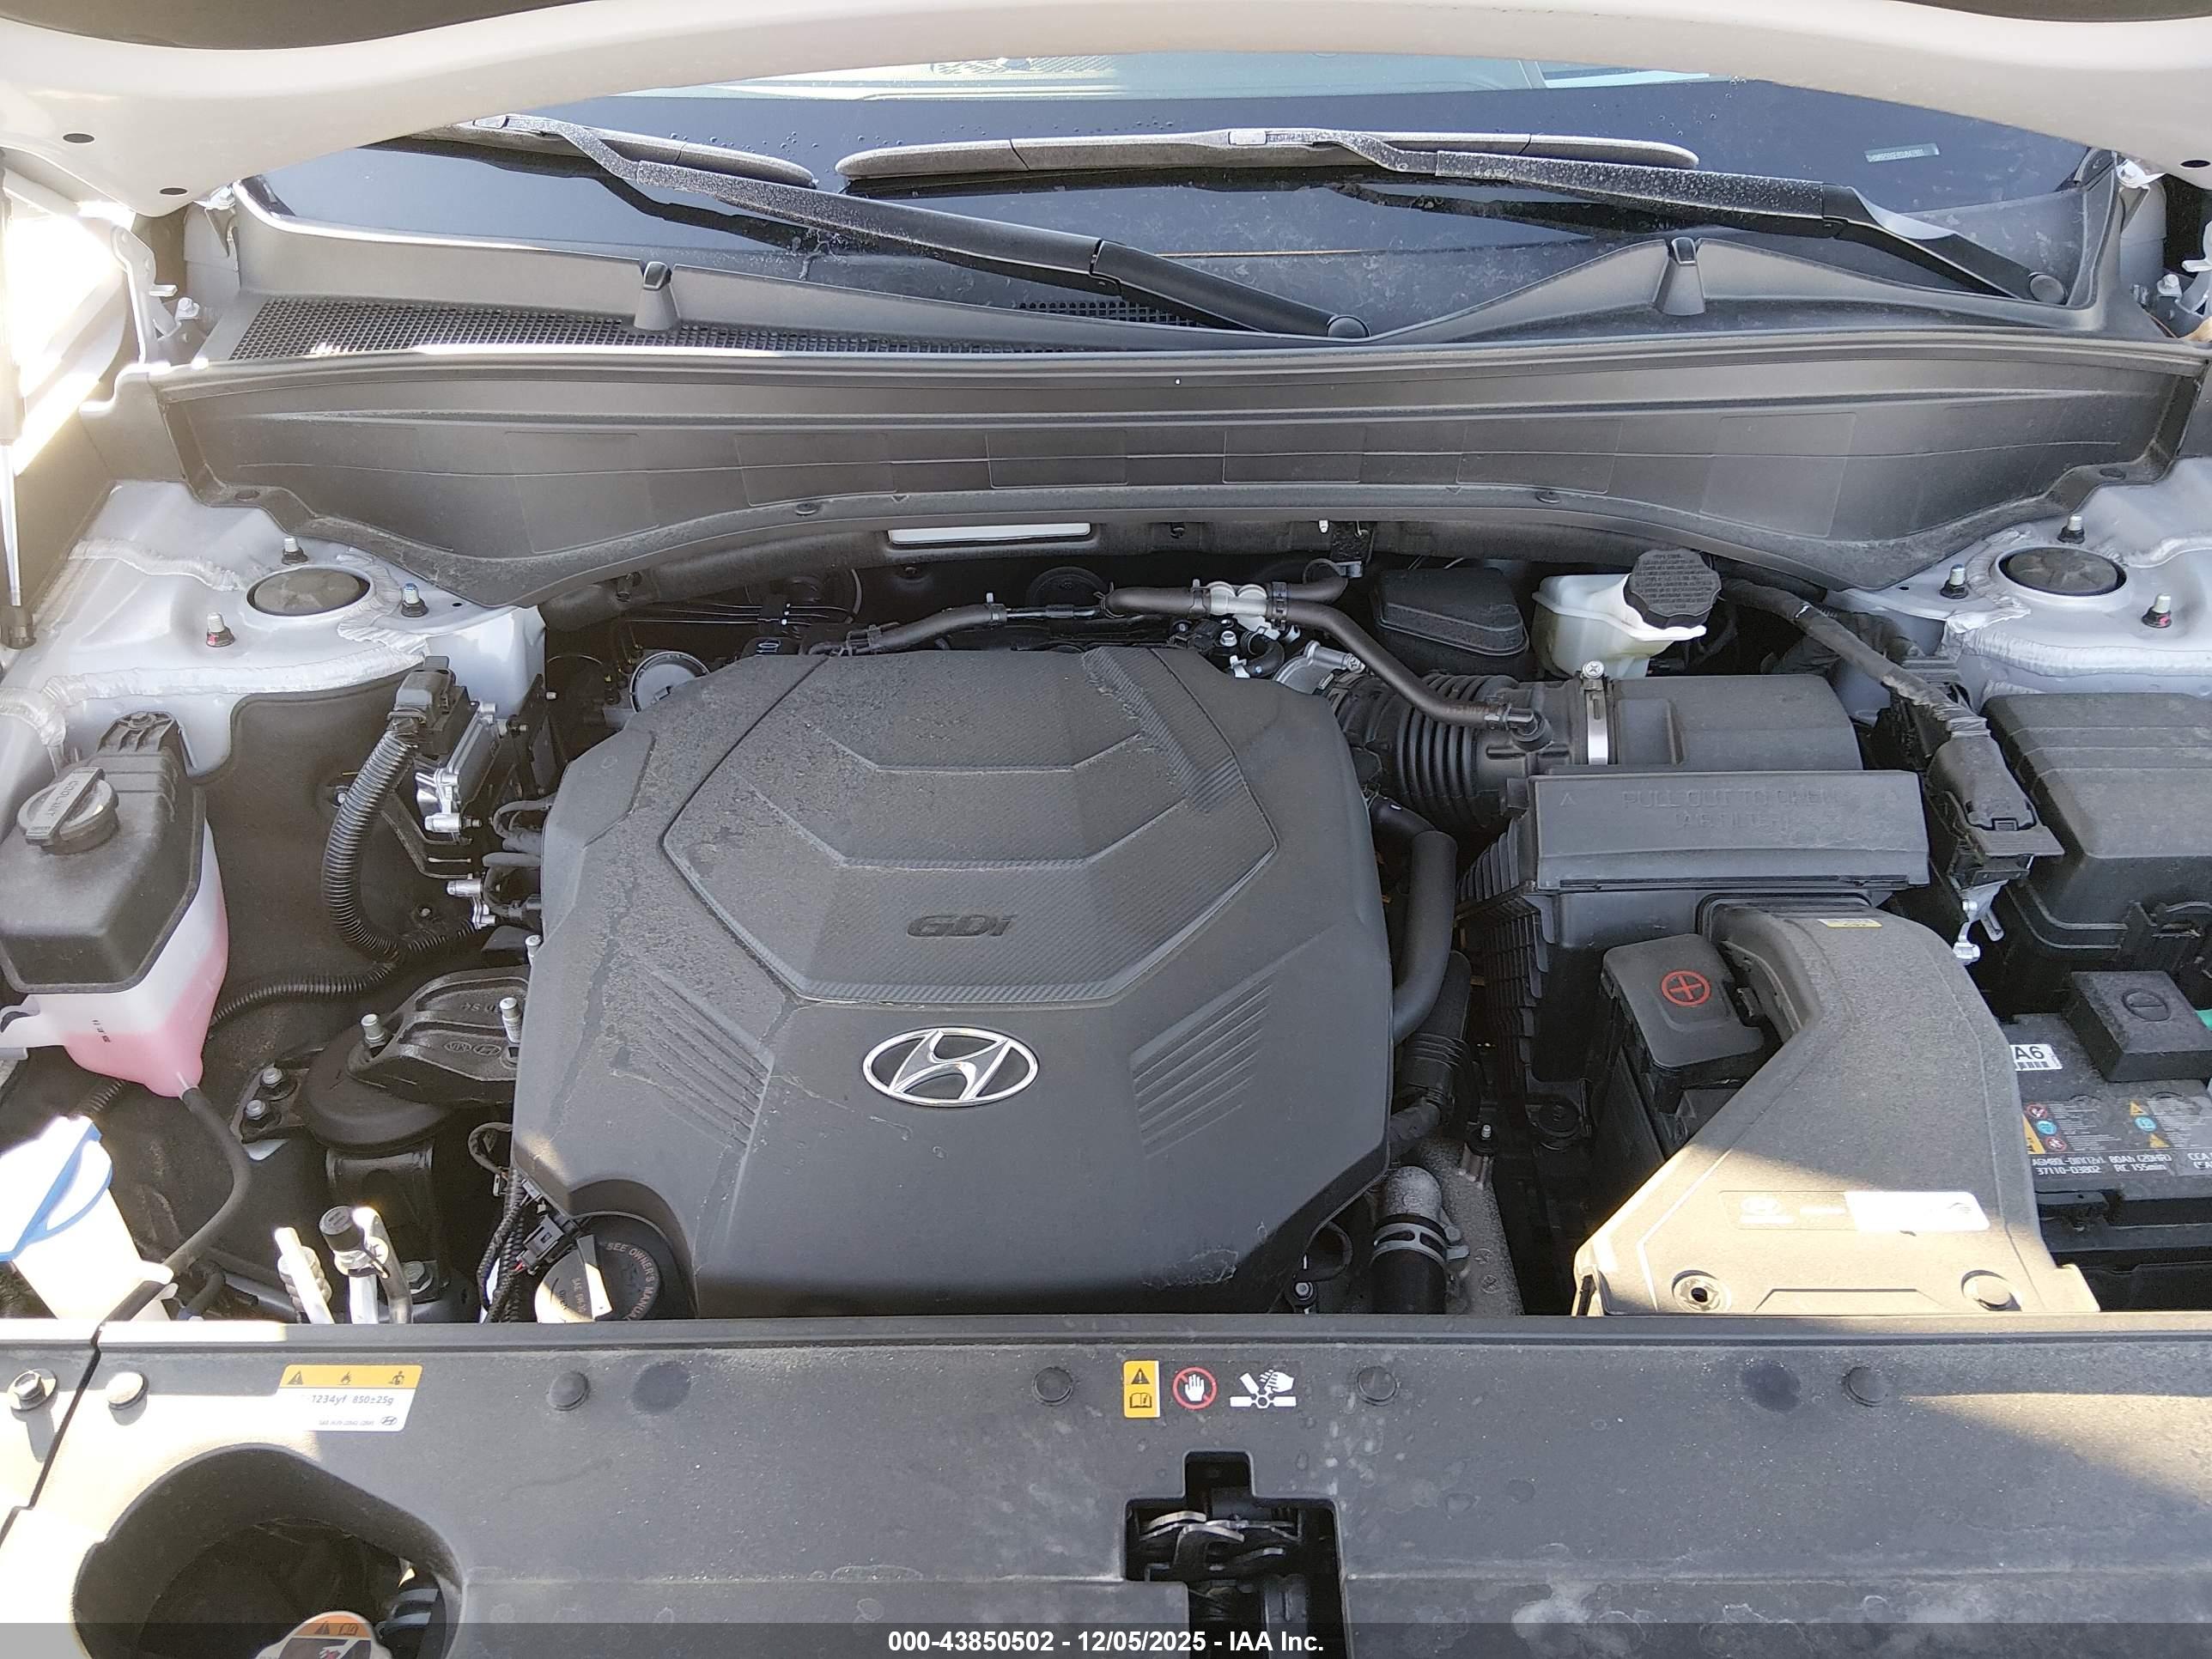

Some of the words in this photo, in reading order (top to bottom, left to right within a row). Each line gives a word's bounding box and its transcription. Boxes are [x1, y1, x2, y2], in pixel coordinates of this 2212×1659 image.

[1622, 789, 1681, 808] PULL
[2014, 1046, 2045, 1060] A6
[606, 1243, 629, 1252] SEE
